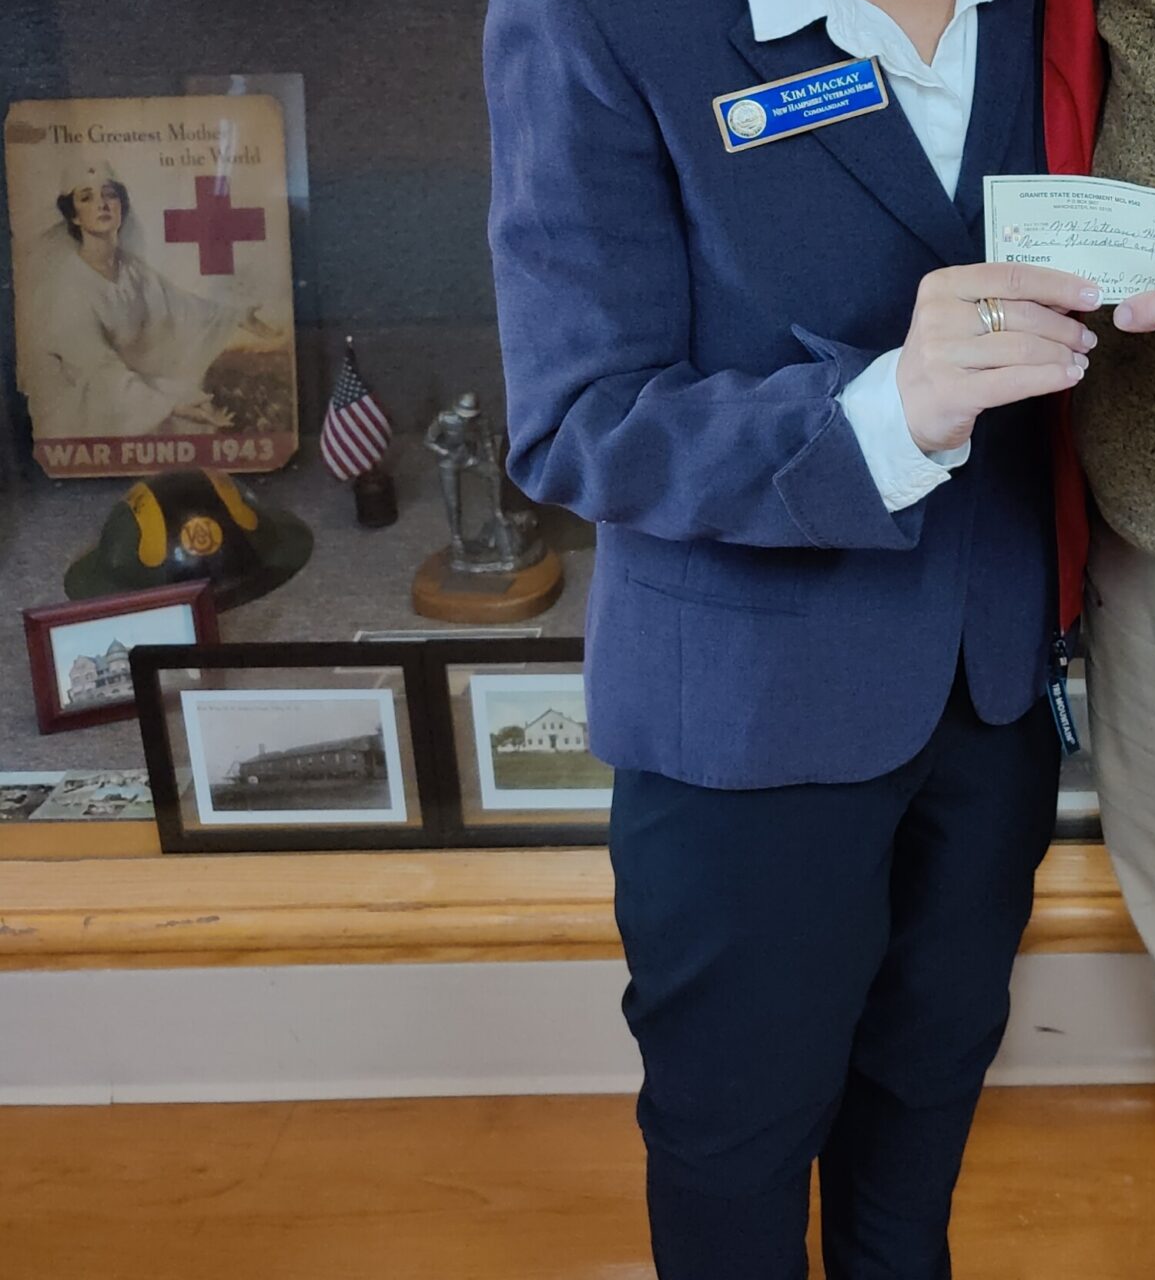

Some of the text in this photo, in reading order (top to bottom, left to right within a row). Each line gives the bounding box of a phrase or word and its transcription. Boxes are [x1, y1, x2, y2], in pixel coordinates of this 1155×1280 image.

[780, 88, 807, 104] KIM
[49, 122, 228, 145] The Greatest Mothe
[159, 152, 174, 167] in
[181, 147, 206, 167] the
[1015, 254, 1051, 263] Citizens
[44, 439, 275, 467] WAR FUND 1943
